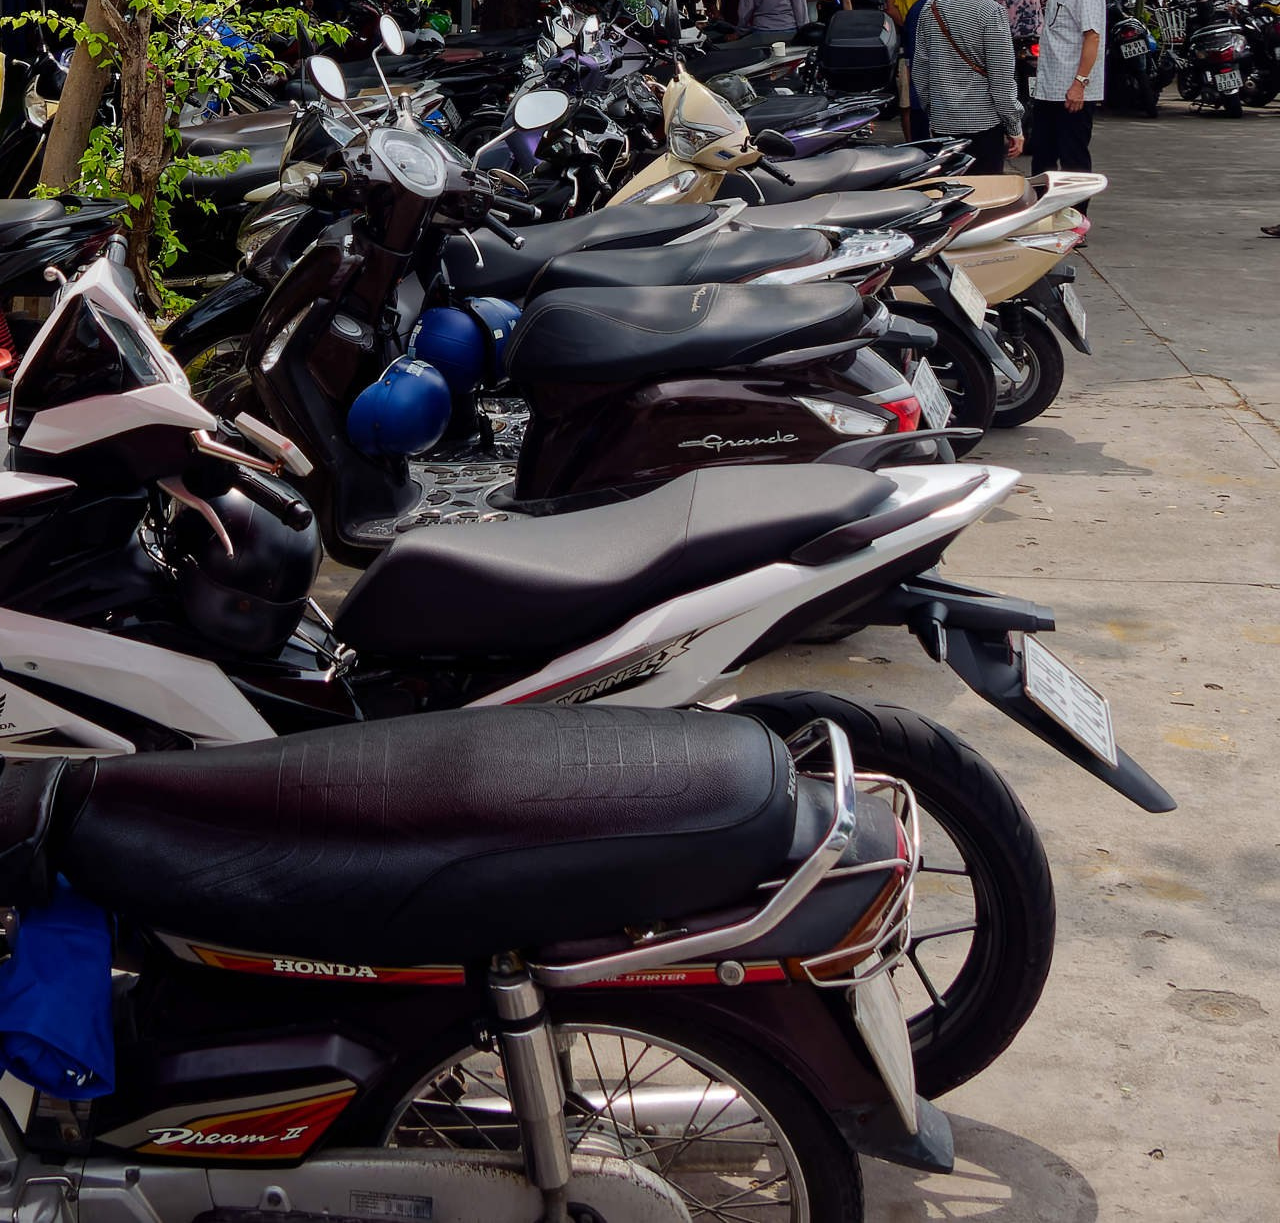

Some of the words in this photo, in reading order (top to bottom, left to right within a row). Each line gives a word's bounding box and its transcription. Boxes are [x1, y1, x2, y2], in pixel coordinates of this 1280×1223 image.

[678, 430, 799, 453] Grande
[273, 958, 378, 979] HONDA
[624, 973, 688, 982] STARTER
[146, 1127, 279, 1146] Dream
[280, 1125, 309, 1142] II
